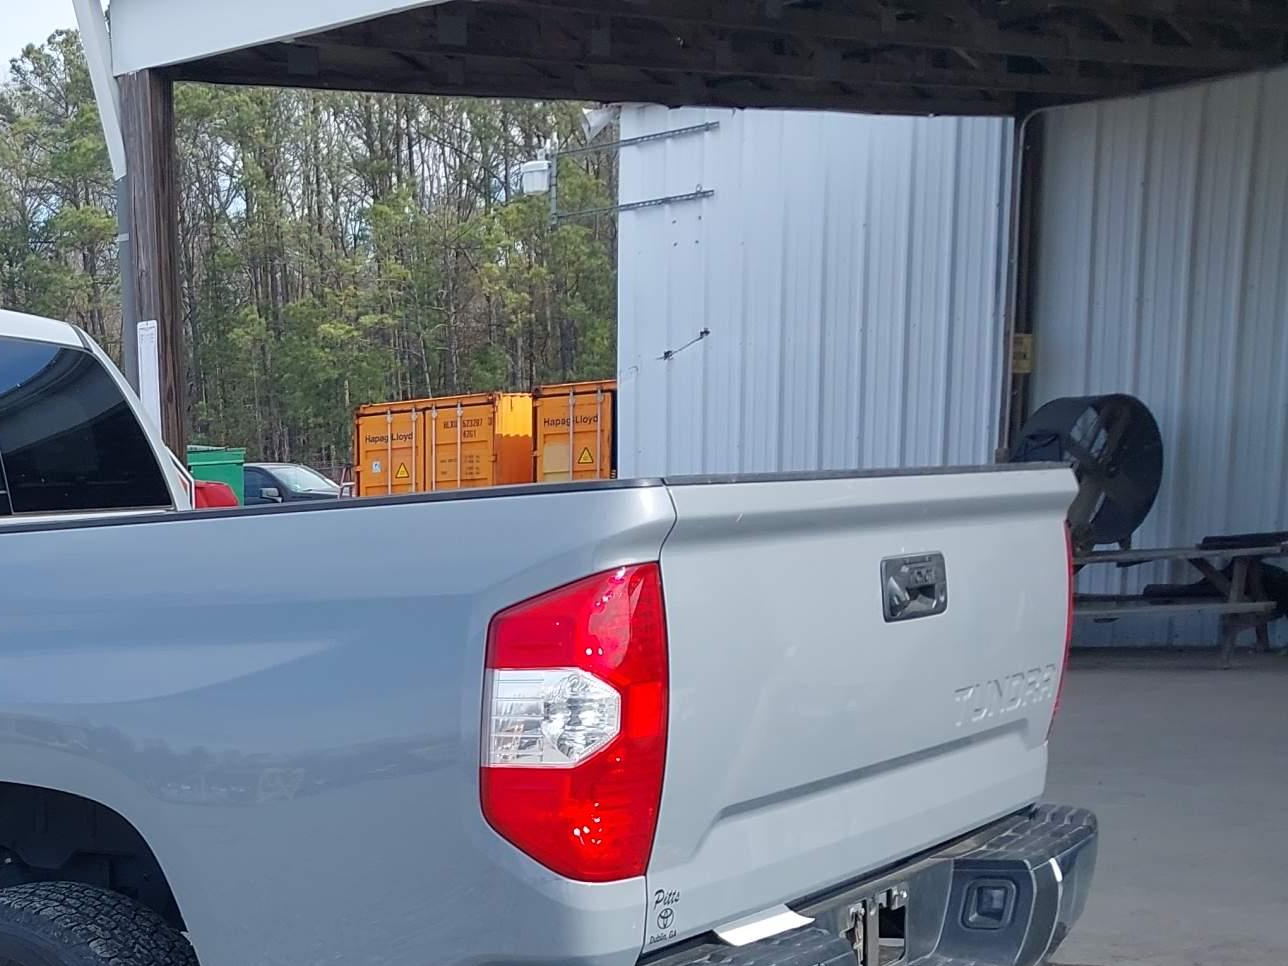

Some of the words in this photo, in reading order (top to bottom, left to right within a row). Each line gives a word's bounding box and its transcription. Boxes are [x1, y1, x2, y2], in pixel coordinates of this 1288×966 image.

[365, 431, 414, 444] HapagLloyd
[954, 663, 1056, 728] TUNDRA
[654, 889, 680, 910] Pitts
